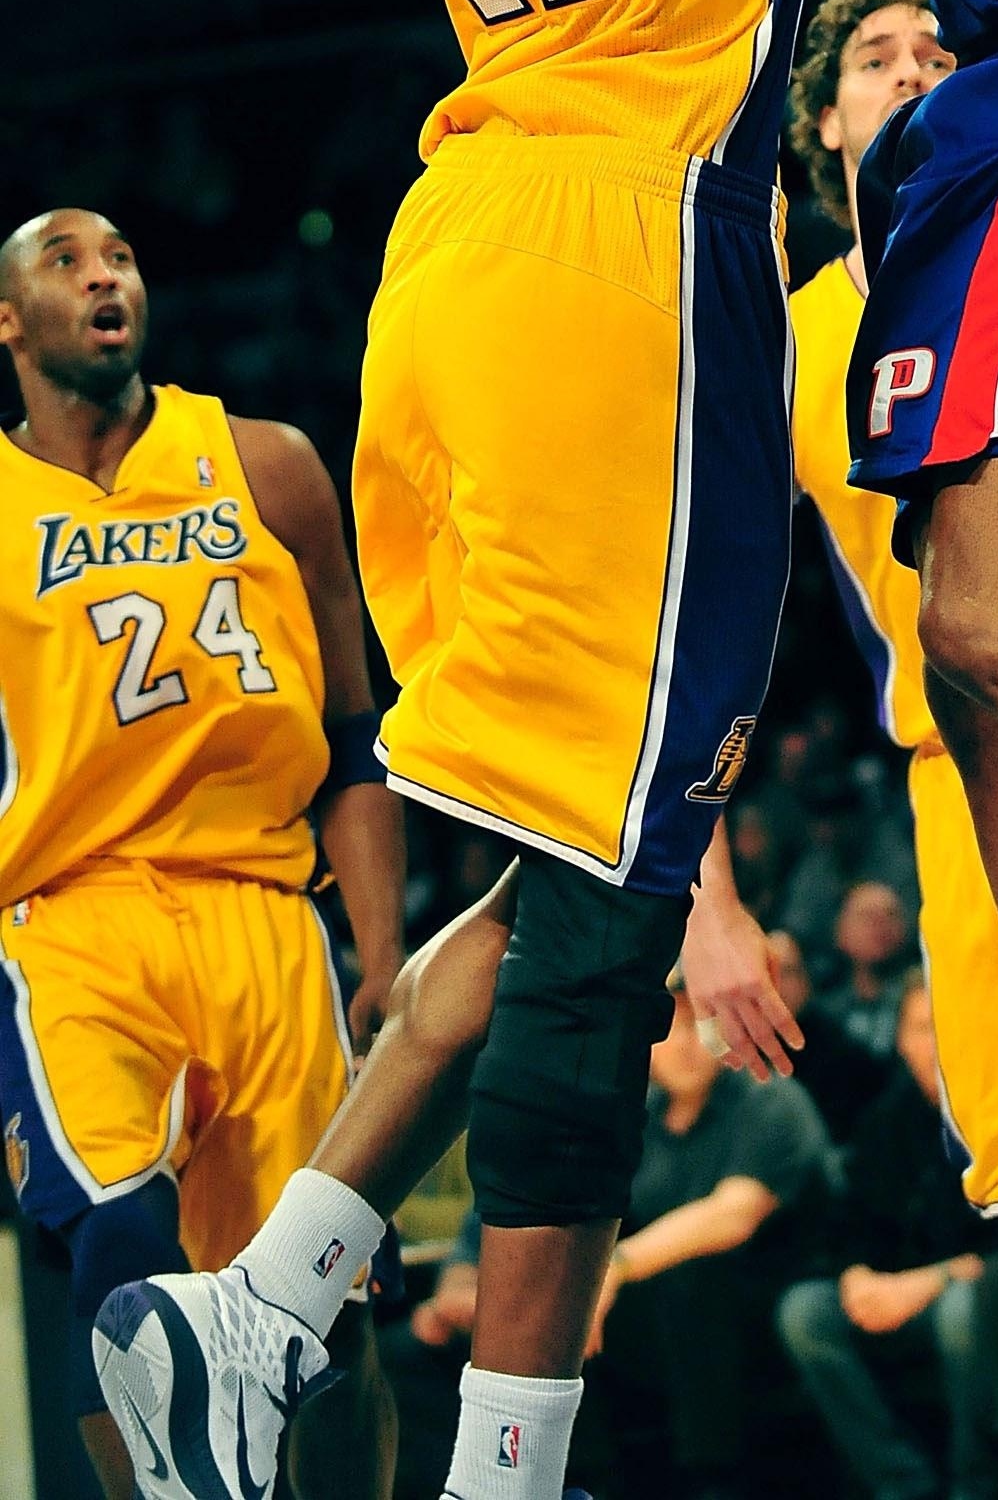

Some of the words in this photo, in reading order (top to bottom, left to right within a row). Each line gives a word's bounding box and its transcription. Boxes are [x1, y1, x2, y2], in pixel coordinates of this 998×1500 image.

[868, 347, 936, 439] P
[36, 497, 248, 599] LAKERS
[87, 577, 277, 726] 24
